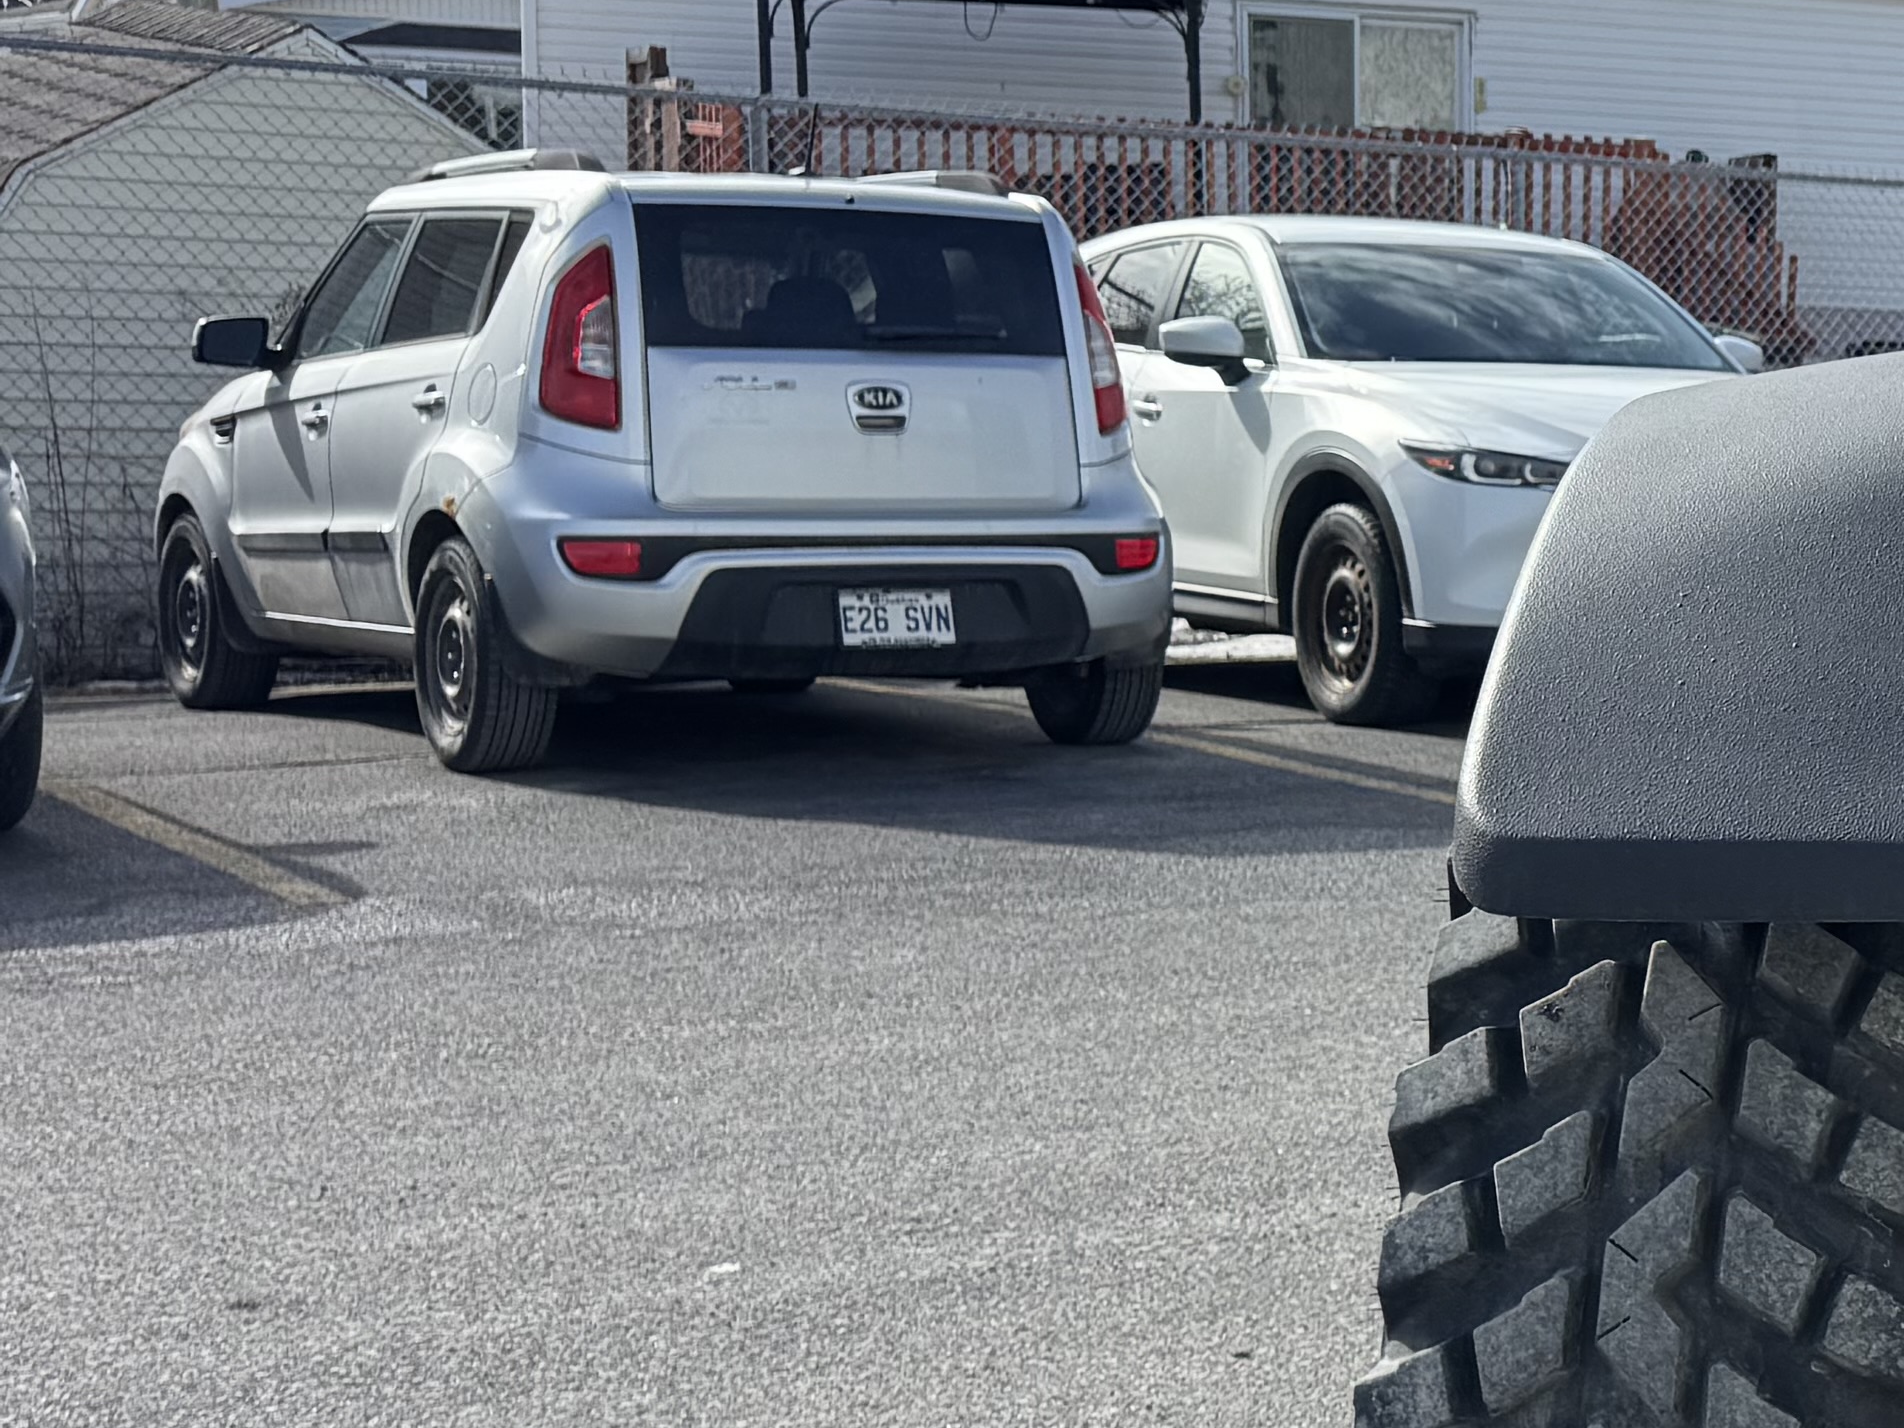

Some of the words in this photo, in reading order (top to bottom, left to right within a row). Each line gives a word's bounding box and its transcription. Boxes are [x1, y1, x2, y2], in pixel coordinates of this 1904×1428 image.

[863, 389, 899, 407] KIA
[842, 605, 888, 633] E26
[904, 603, 951, 633] SVN
